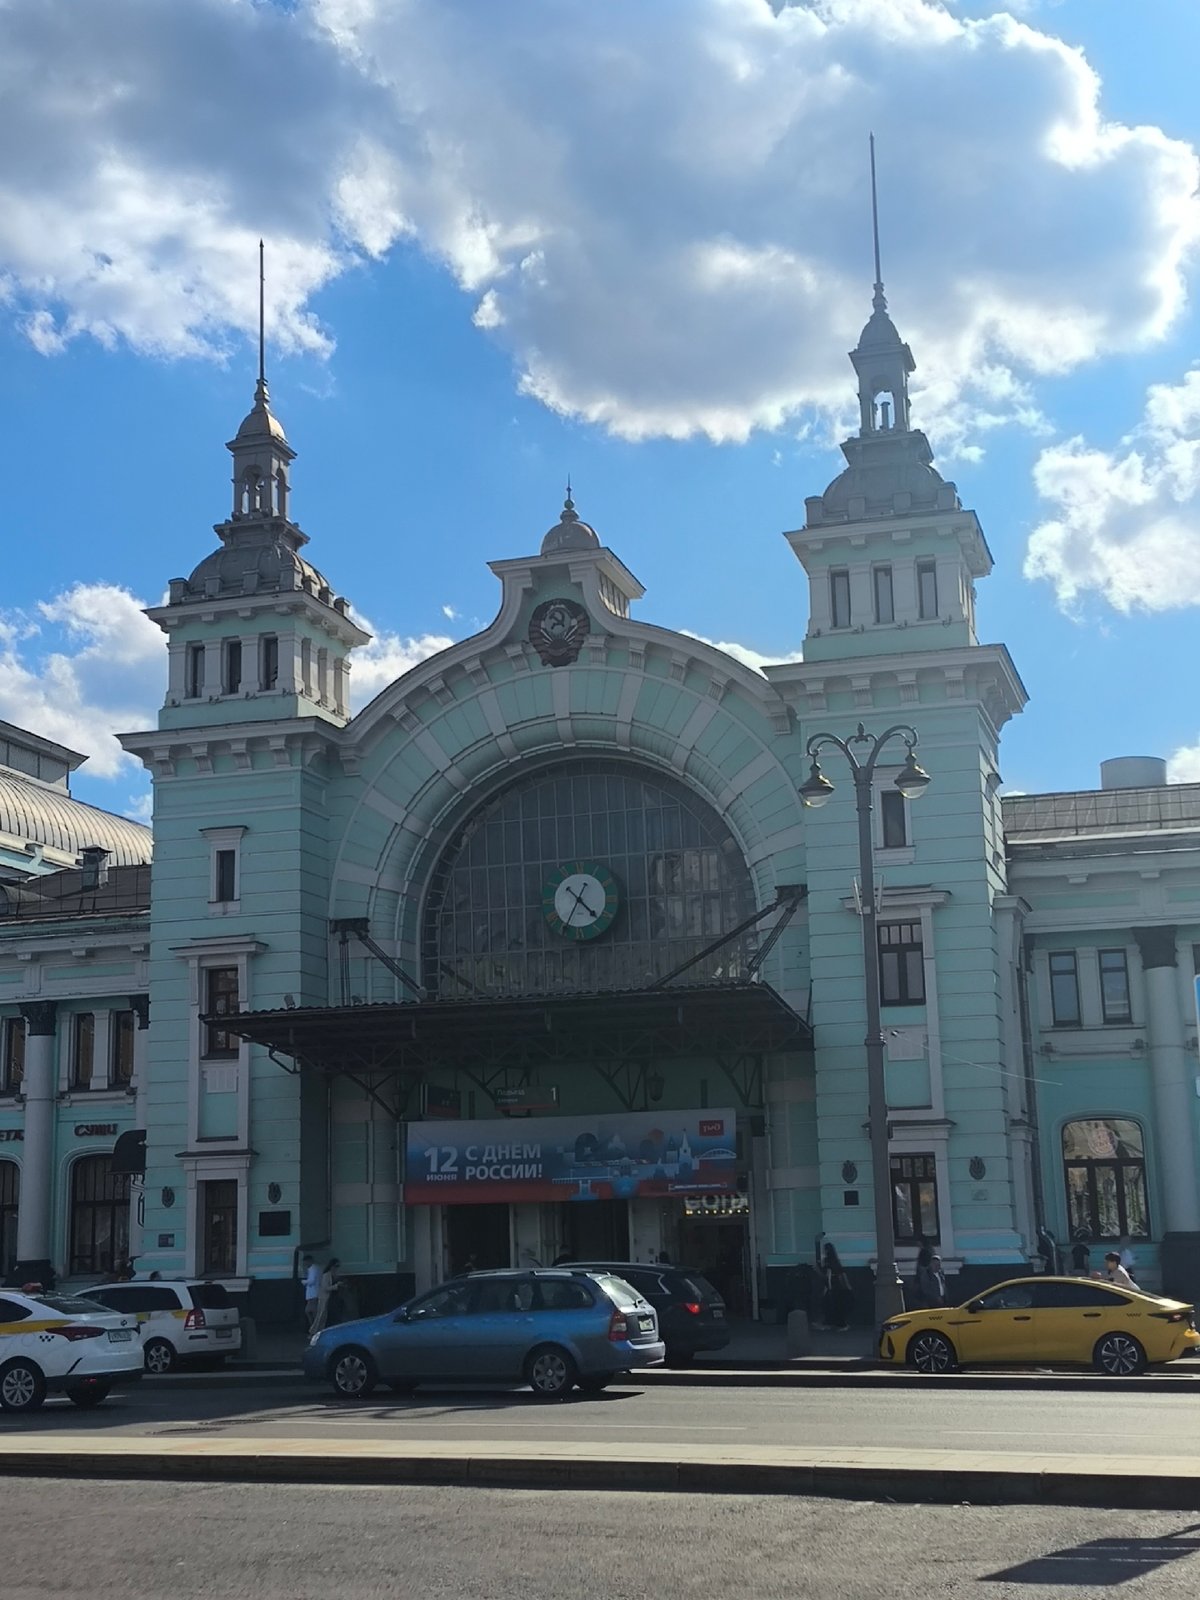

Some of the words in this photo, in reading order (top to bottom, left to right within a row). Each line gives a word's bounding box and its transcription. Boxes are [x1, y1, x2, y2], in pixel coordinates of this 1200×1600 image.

[550, 1087, 557, 1101] 1
[424, 1146, 459, 1173] 12
[465, 1145, 478, 1161] С
[426, 1173, 458, 1182] ИЮНЯ
[465, 1163, 543, 1181] РОССИИ!
